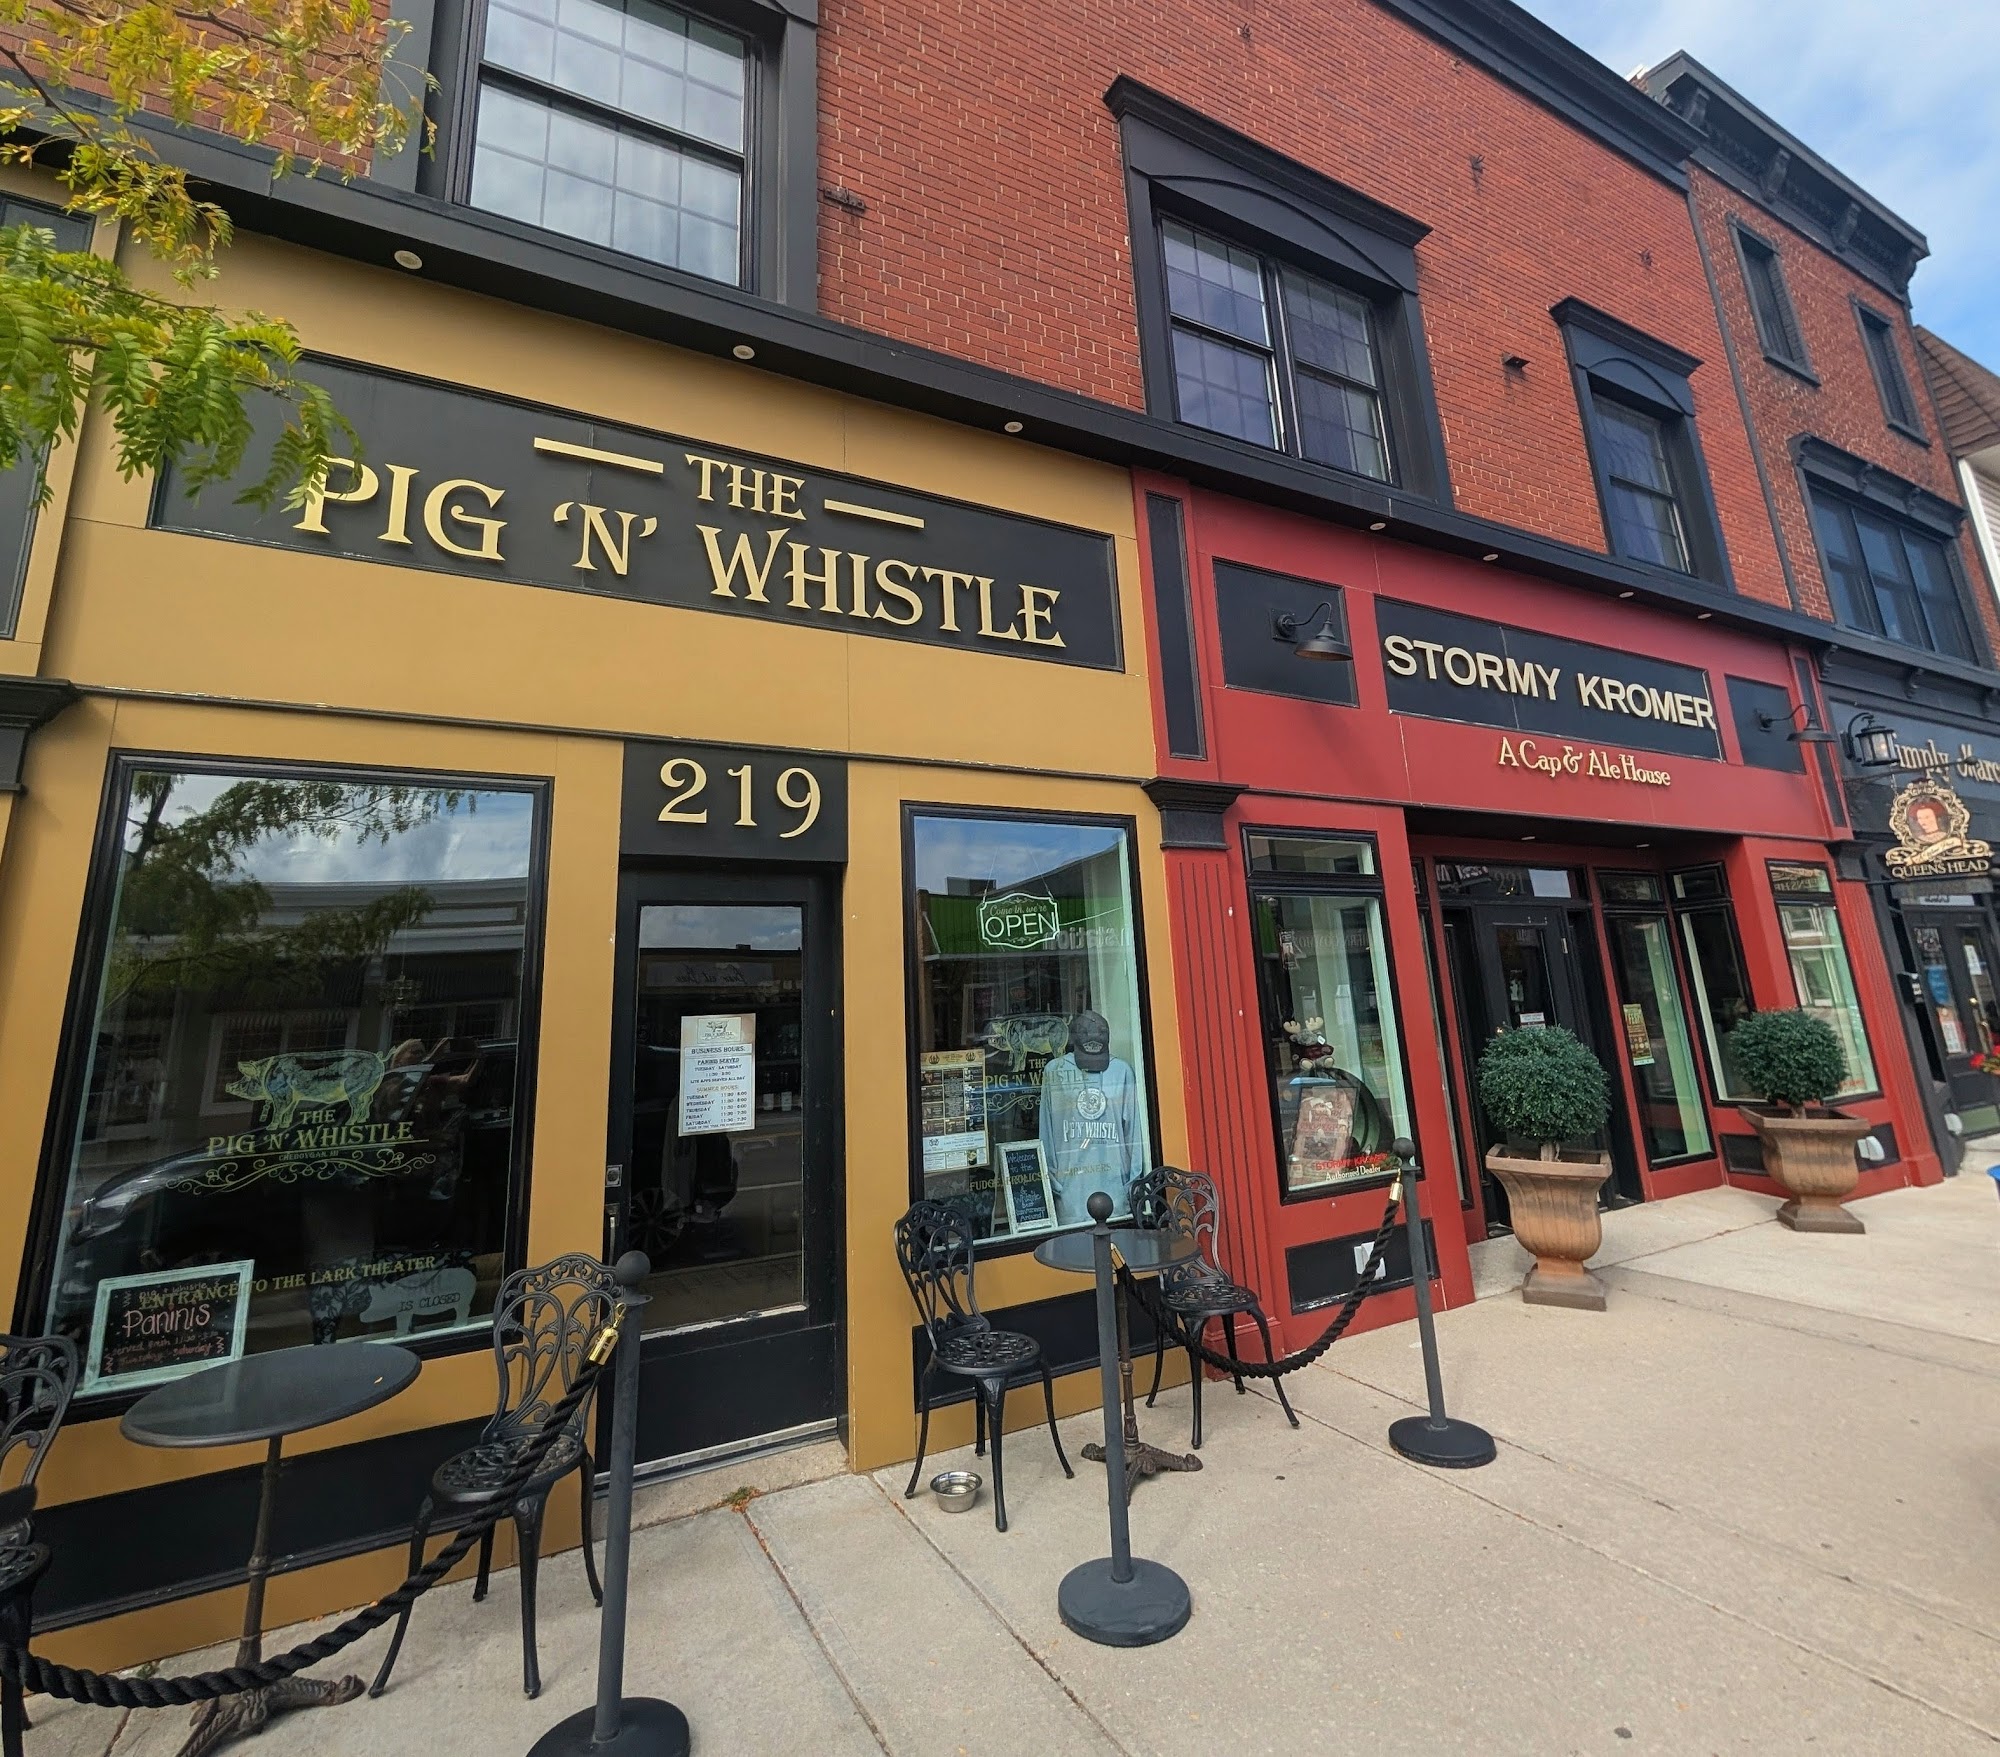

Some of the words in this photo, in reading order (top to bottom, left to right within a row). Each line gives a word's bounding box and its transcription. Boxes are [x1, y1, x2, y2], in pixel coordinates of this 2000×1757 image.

[685, 453, 807, 521] THE
[292, 453, 509, 562] PIG
[553, 501, 658, 576] 'N'
[696, 524, 1067, 648] WHISTLE
[1383, 634, 1561, 701] STORMY
[1577, 673, 1717, 730] KROMER
[1498, 736, 1519, 767] A
[1519, 740, 1561, 778] Cap
[1562, 745, 1583, 774] &
[1586, 748, 1621, 780] Ale
[1620, 754, 1672, 787] House
[657, 757, 821, 839] 219
[1949, 859, 1989, 874] HEAD
[984, 911, 1056, 938] OPEN
[691, 1047, 722, 1055] BUSINESS
[985, 1073, 1009, 1090] PIG
[299, 1109, 336, 1125] THE
[206, 1134, 256, 1158] PIG
[296, 1121, 415, 1149] WHISTLE
[1360, 1163, 1381, 1176] Dealer
[272, 1273, 306, 1290] THE
[310, 1265, 356, 1285] LARK
[362, 1255, 436, 1279] THEATER
[418, 1292, 461, 1309] CLOSED
